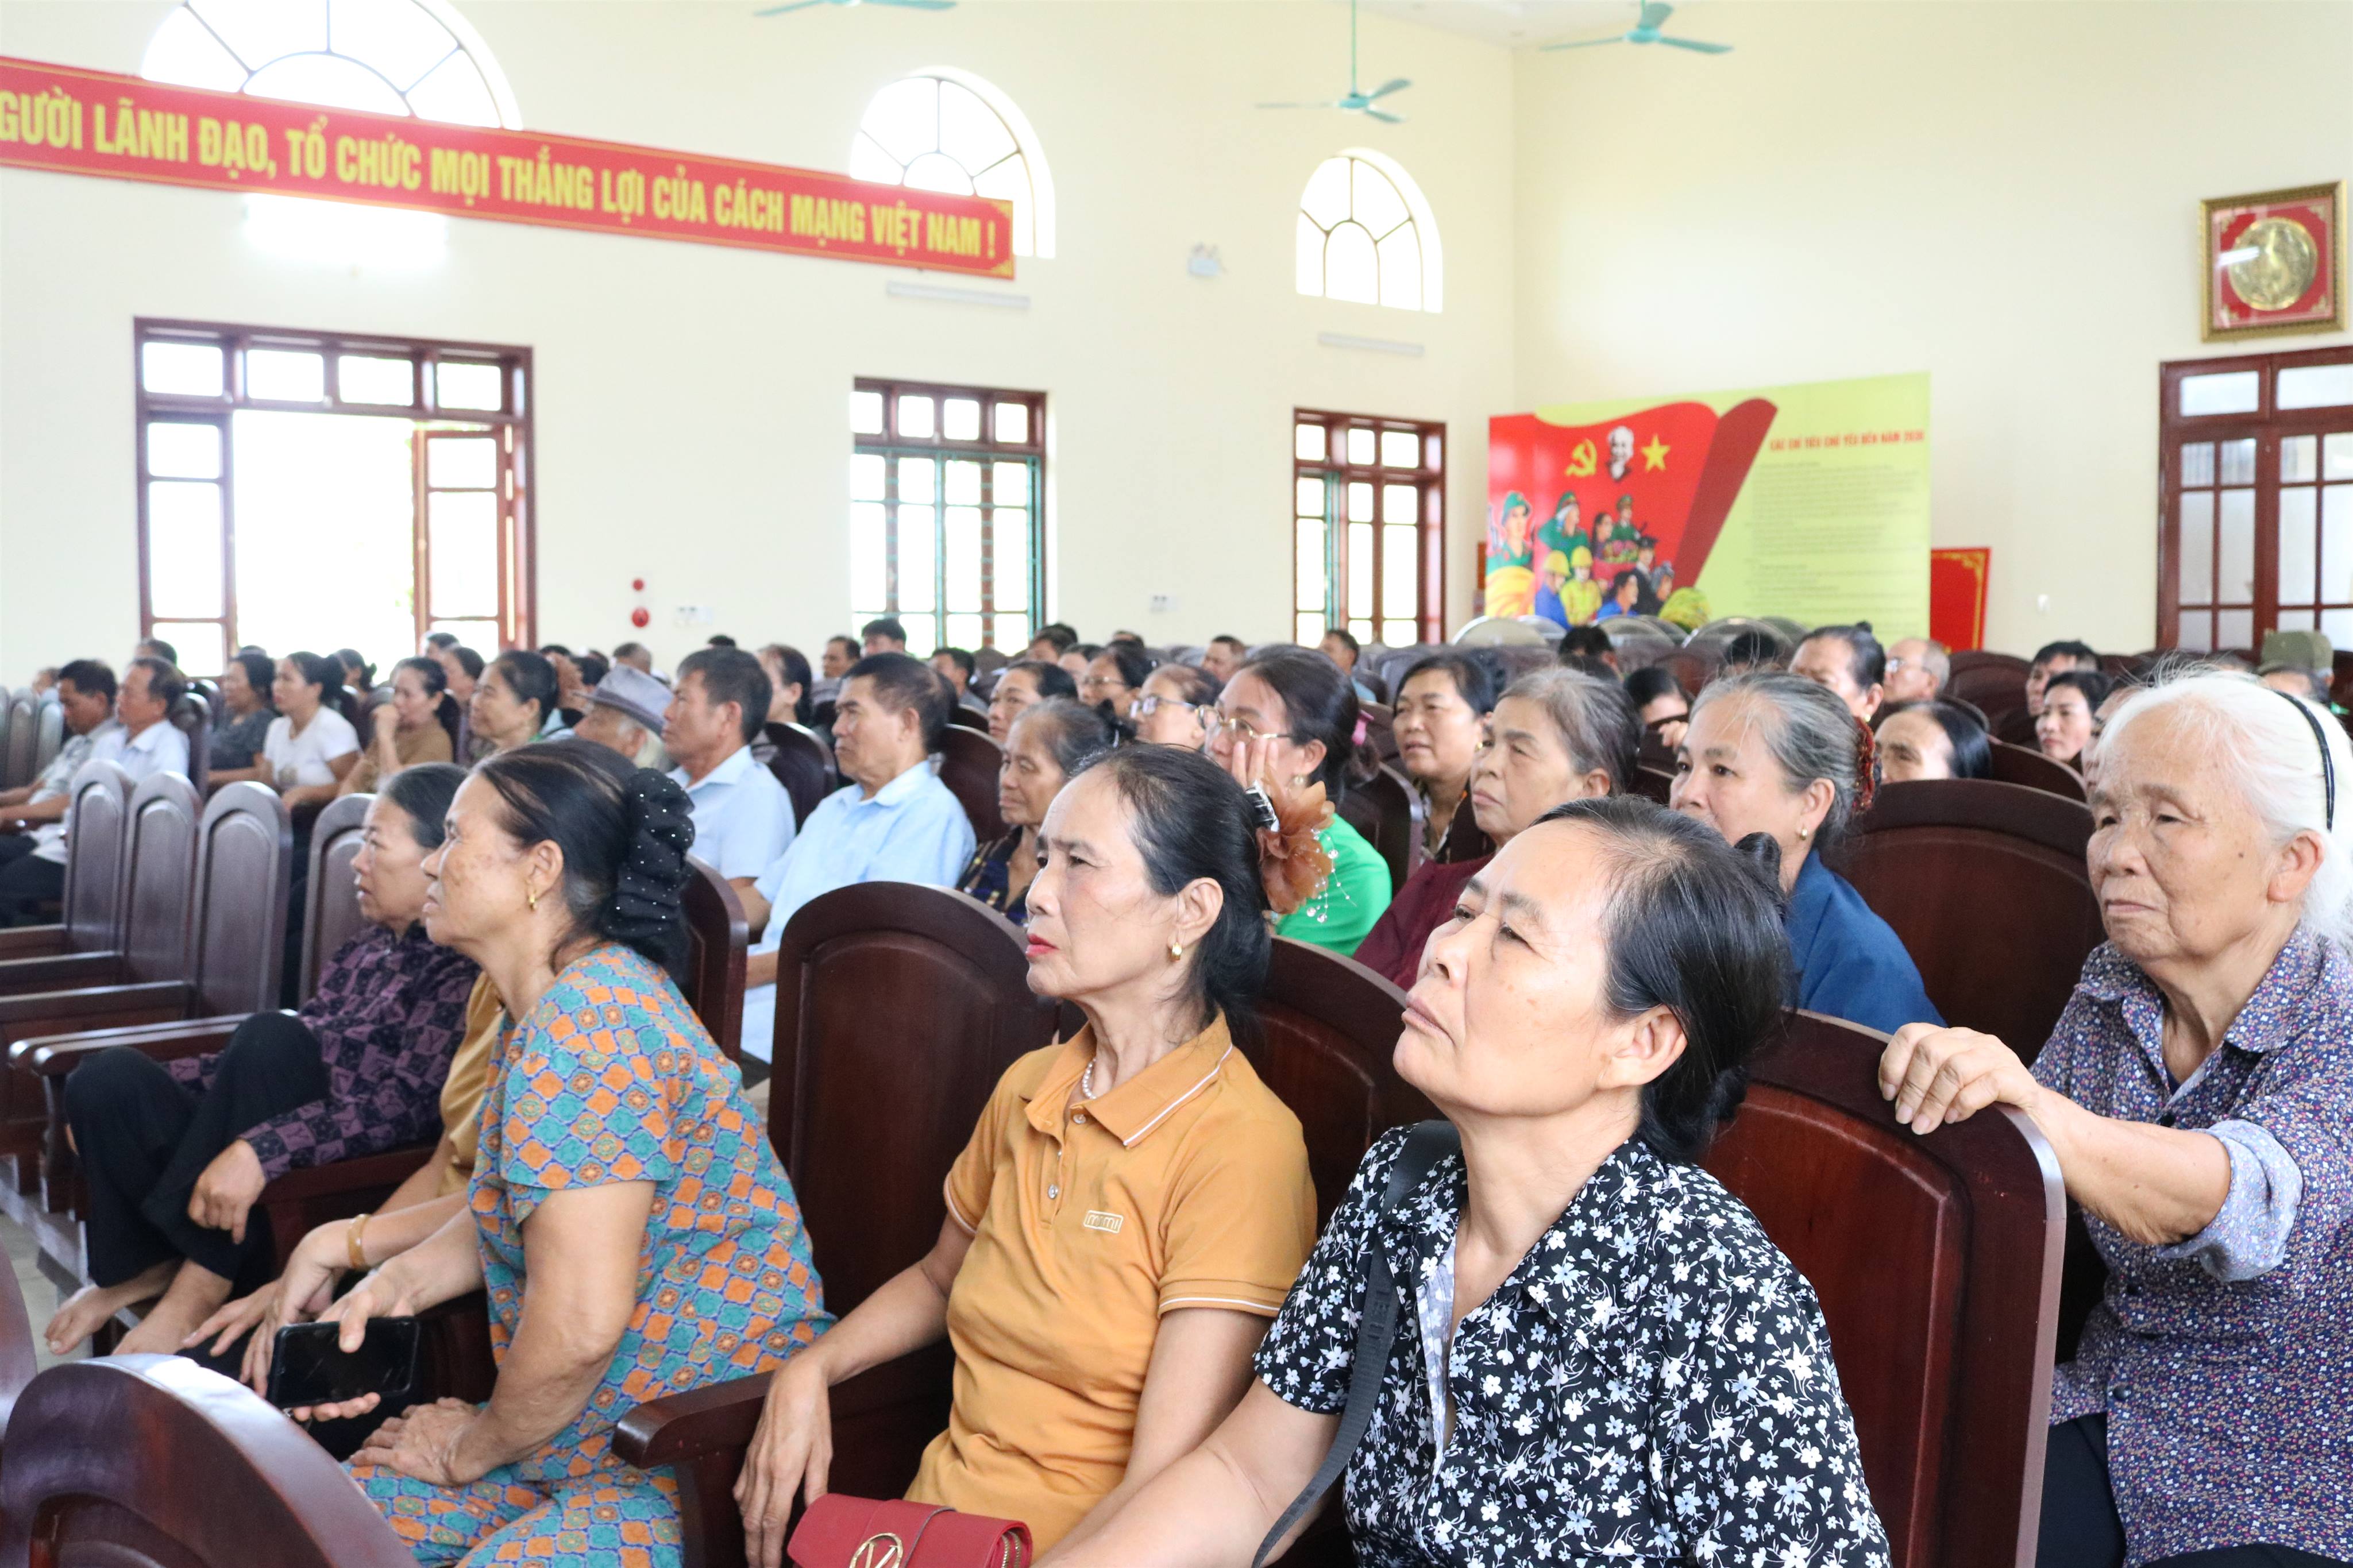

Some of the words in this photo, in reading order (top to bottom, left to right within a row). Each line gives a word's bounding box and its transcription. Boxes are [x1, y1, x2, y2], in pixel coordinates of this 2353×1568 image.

[94, 97, 188, 163] LÃNH
[199, 118, 276, 179] ĐẠO,
[286, 116, 327, 179] TỔ
[337, 133, 422, 190] CHỨC
[431, 147, 489, 206] MỌI
[497, 145, 594, 210] THẮNG
[602, 169, 645, 223] LỢI
[653, 165, 707, 223] CỦA
[714, 179, 784, 231] CÁCH
[791, 194, 865, 247] MẠNG
[871, 200, 922, 256] VIỆT
[927, 213, 980, 256] NAM
[988, 220, 996, 258] !
